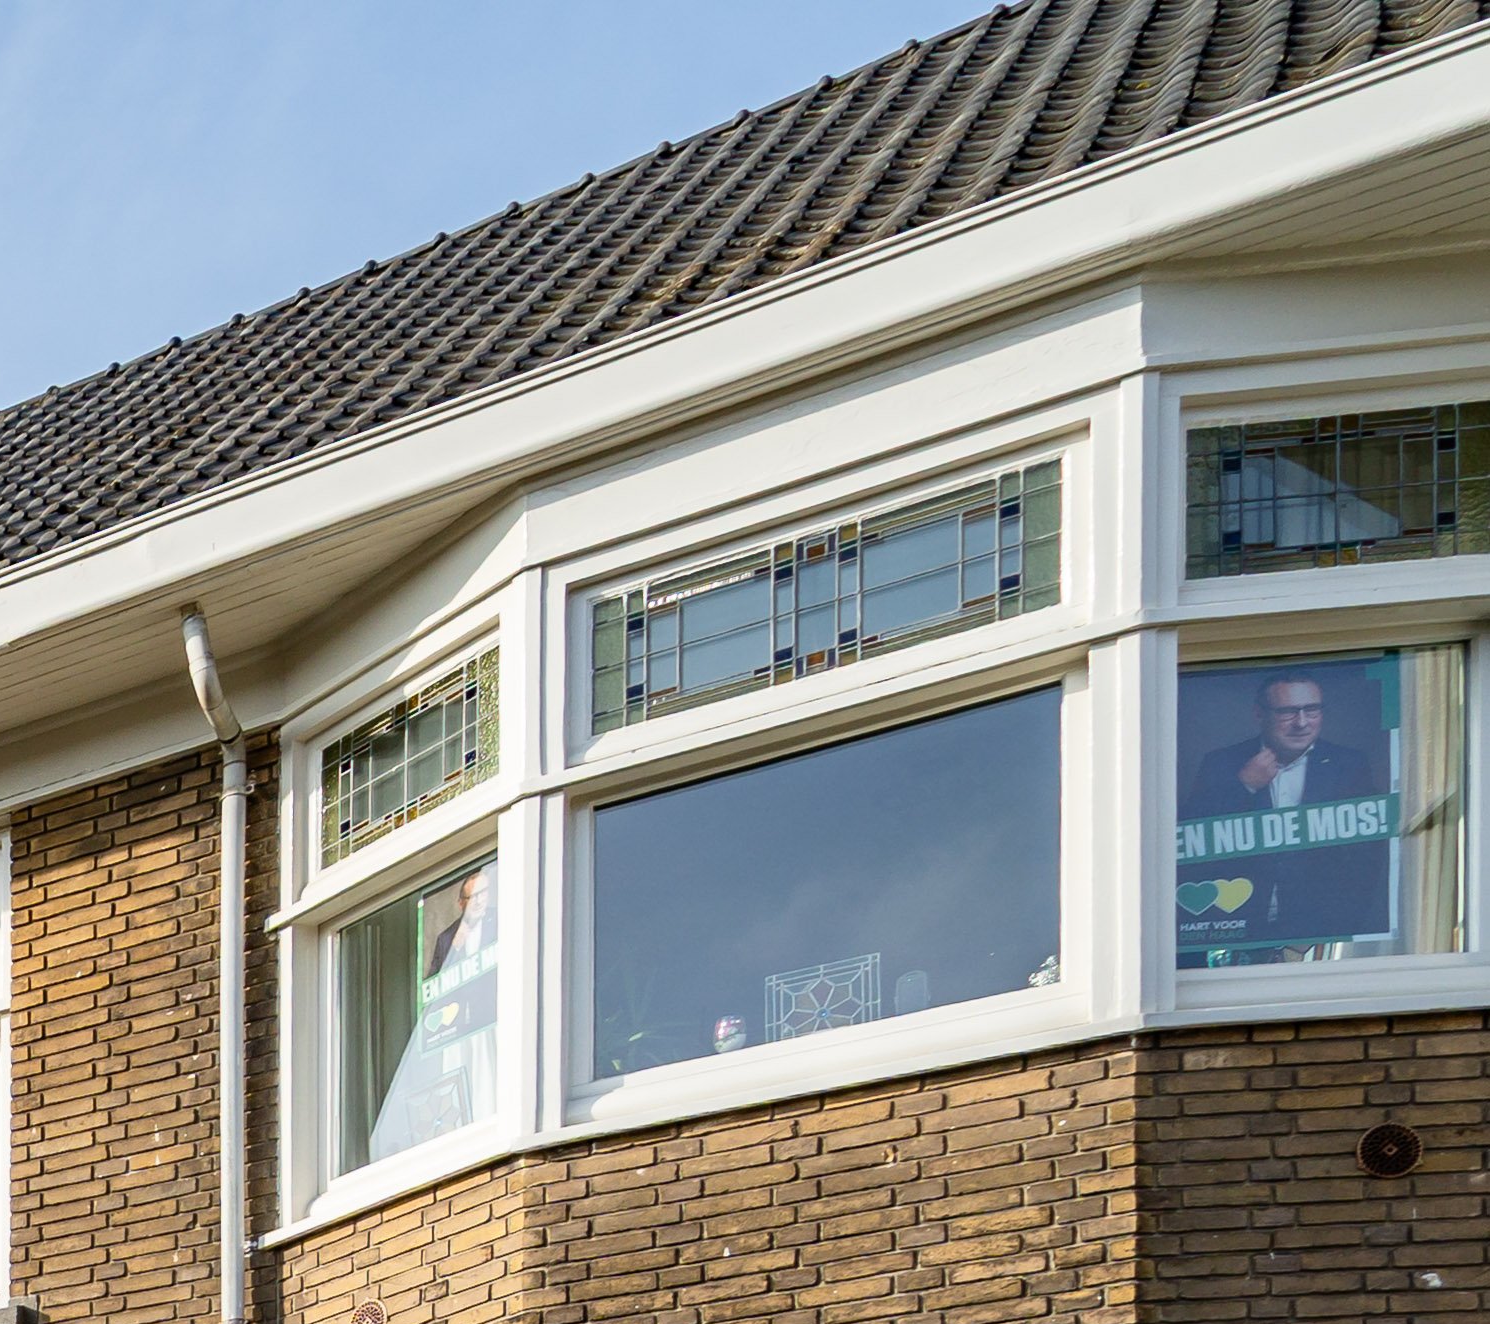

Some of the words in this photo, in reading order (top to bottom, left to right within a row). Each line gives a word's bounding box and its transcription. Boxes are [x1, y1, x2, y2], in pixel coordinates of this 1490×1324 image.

[1213, 817, 1256, 854] NU
[1262, 811, 1300, 848] DE
[1307, 800, 1388, 843] MOS!
[1179, 921, 1210, 931] HART
[1212, 920, 1247, 930] VOOR
[422, 976, 439, 1004] EN
[441, 964, 459, 994] NU
[461, 954, 479, 982] DE
